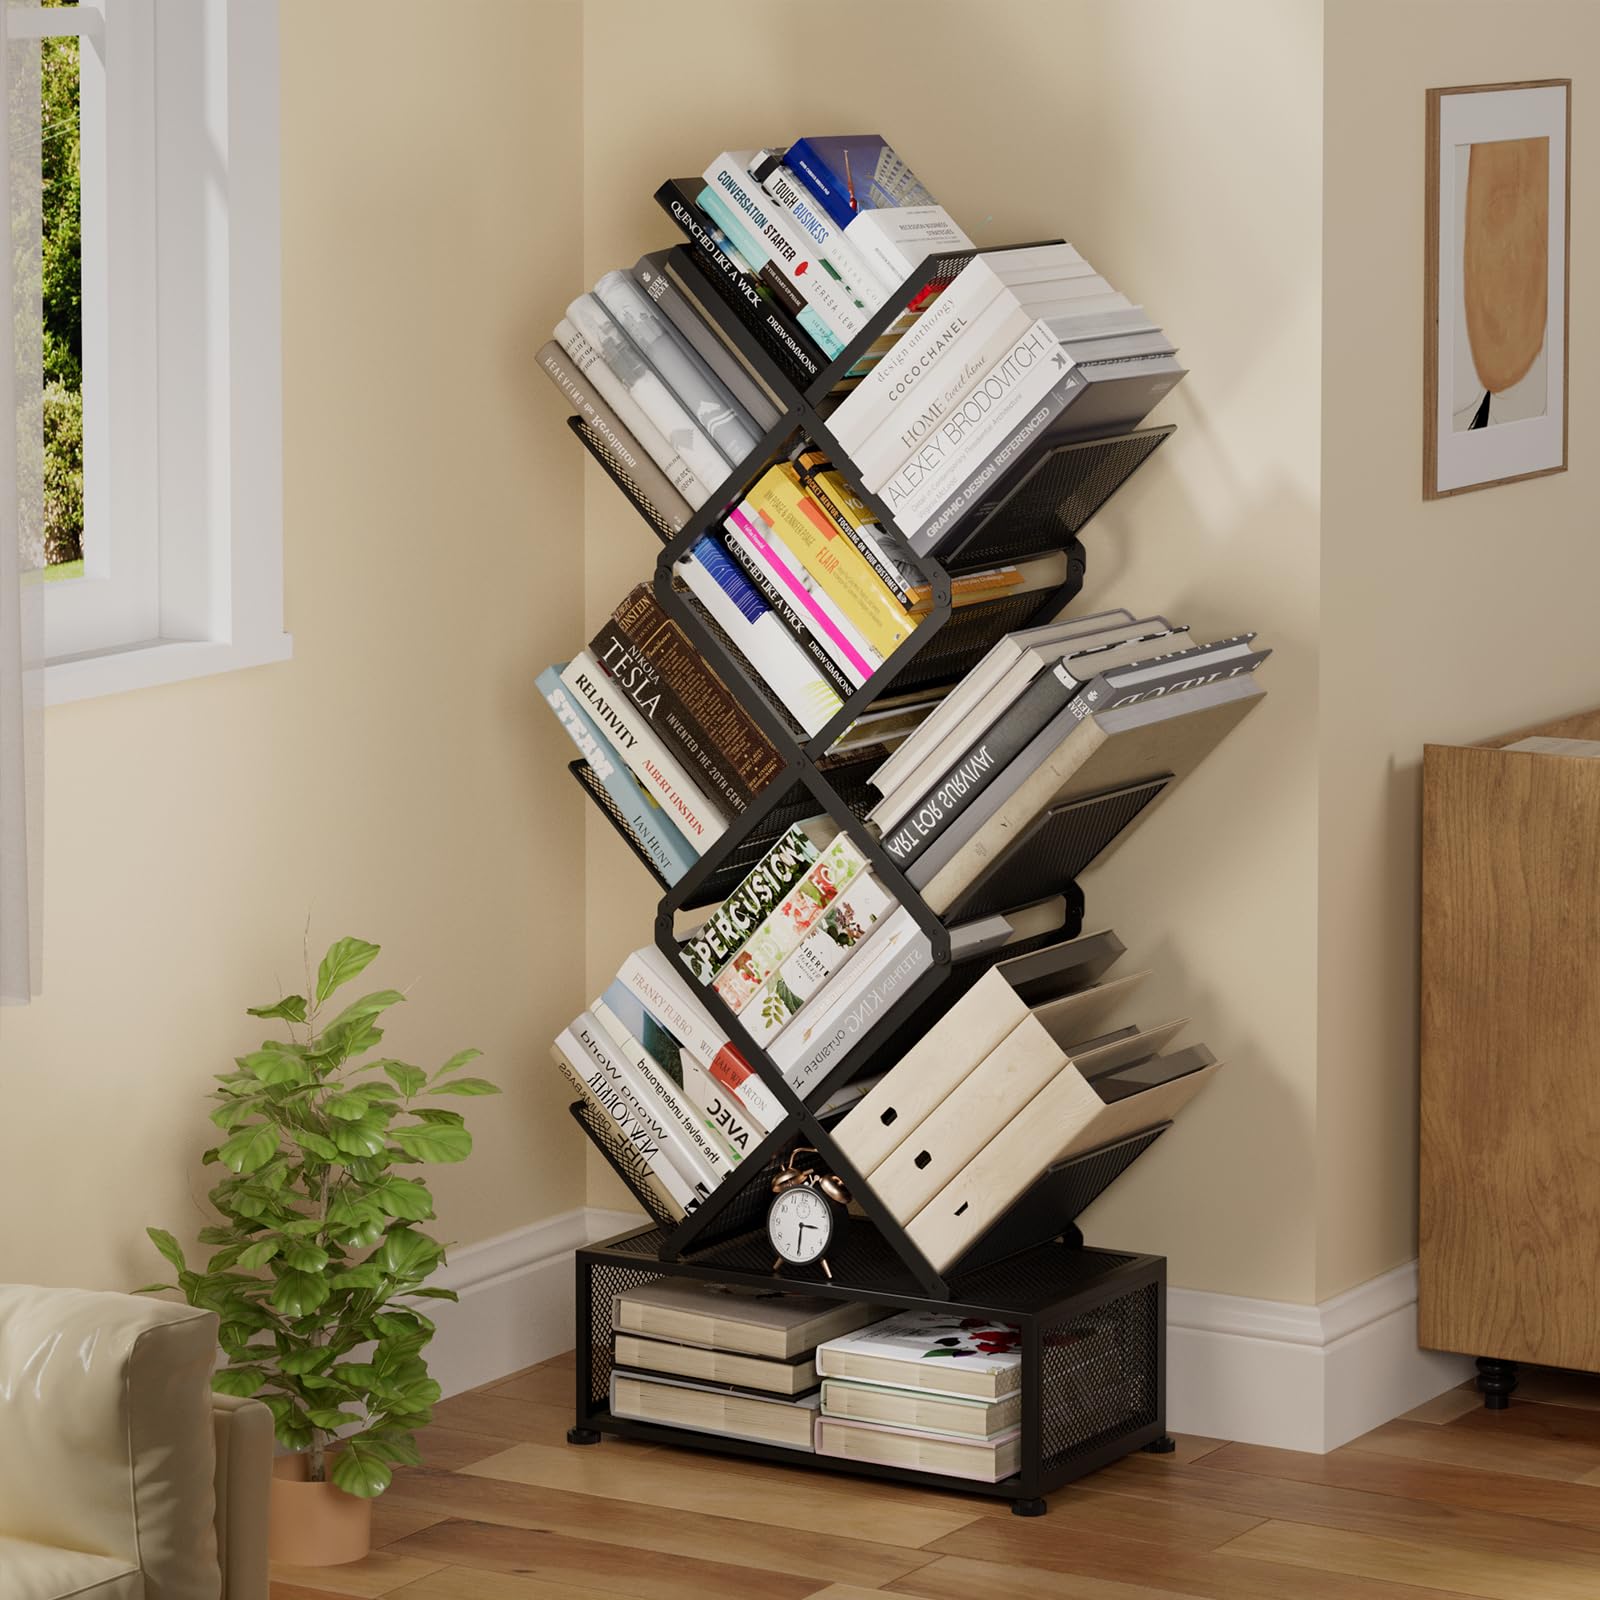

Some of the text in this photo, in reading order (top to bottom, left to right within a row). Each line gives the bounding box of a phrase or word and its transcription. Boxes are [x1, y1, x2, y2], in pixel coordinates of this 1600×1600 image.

[717, 170, 769, 229] CONVERSATION
[763, 224, 797, 262] STARTER
[772, 178, 799, 209] TOUGH
[793, 203, 829, 244] BUSINESS
[671, 200, 762, 308] QUENCHED LIKE A WICK
[811, 280, 838, 313] TERESA
[766, 315, 817, 374] DREW SIMMONS
[877, 350, 908, 383] design
[886, 334, 1045, 508] ALEXEY BRODOVITCH
[900, 397, 947, 449] HOME
[926, 496, 966, 538] GRAPHIC
[965, 463, 997, 500] DESIGN
[994, 407, 1050, 465] REFERENCED
[804, 475, 821, 497] POCKET
[820, 494, 839, 519] MENTOR:
[838, 516, 859, 544] FOCUSING
[858, 542, 866, 552] ON
[864, 549, 877, 566] YOUR
[875, 564, 899, 595] CUSTOMER
[814, 546, 841, 574] FLAIR
[619, 595, 651, 632] EINSTEIN
[724, 533, 764, 582] QUENCHED
[761, 579, 778, 600] LIKE
[774, 599, 783, 609] A
[783, 607, 805, 635] WICK
[601, 635, 662, 720] TESLA
[628, 644, 661, 685] NIKOLA
[808, 640, 853, 697] DREW SIMMONS
[575, 673, 639, 750] RELATIVITY
[666, 712, 698, 754] INVENTED
[696, 750, 711, 768] THE
[708, 766, 728, 792] 20TH
[642, 759, 705, 836] ALBERT EINSTEIN
[633, 815, 672, 869] IAN HUNT
[631, 972, 666, 1009] FRANKY
[664, 1002, 694, 1037] FURBO
[700, 1039, 731, 1078] WILLIAM
